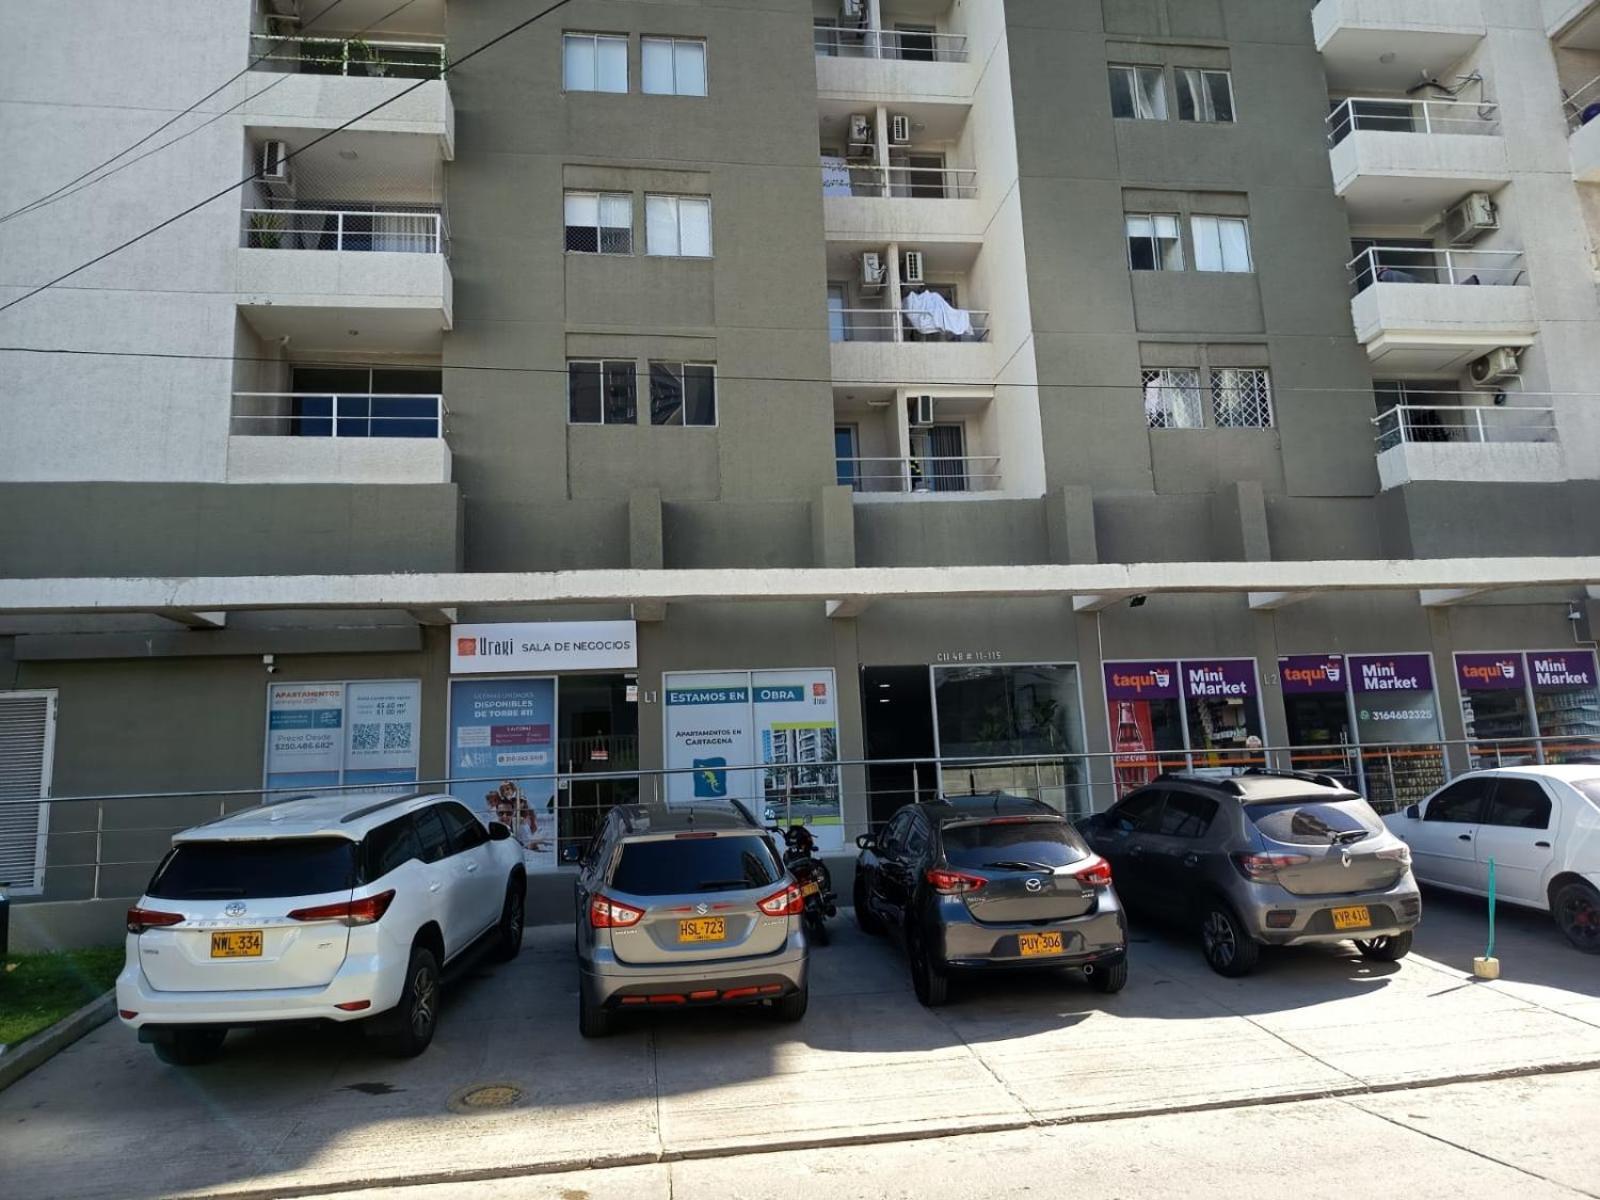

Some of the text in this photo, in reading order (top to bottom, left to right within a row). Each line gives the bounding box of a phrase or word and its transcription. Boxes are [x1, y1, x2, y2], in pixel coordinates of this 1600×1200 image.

[521, 642, 551, 653] SALA
[554, 642, 570, 652] DE
[573, 640, 631, 651] NEGOCIOS
[1361, 662, 1395, 677] Mini
[1534, 658, 1567, 672] Mini
[1189, 666, 1224, 682] Mini
[1263, 673, 1279, 686] L2
[1284, 667, 1327, 686] taqui
[1463, 664, 1501, 683] taqui
[1536, 671, 1589, 685] Market
[1113, 672, 1155, 693] taqui
[1191, 681, 1248, 695] Market
[1364, 676, 1418, 690] Market
[275, 690, 340, 698] APARTAMENTOS
[644, 690, 657, 703] L1
[670, 689, 796, 703] ESTAMOS EN OBRA
[474, 700, 534, 709] DISPONIBLES
[489, 709, 519, 717] TORRE
[1372, 710, 1433, 720] 3164682325
[675, 730, 731, 738] APARTAMENTOS
[685, 738, 733, 746] CARTAGENA
[1335, 911, 1350, 922] KVR
[681, 920, 724, 936] HSL 723
[213, 935, 260, 951] NWL 334
[1021, 935, 1061, 950] PUY 306
